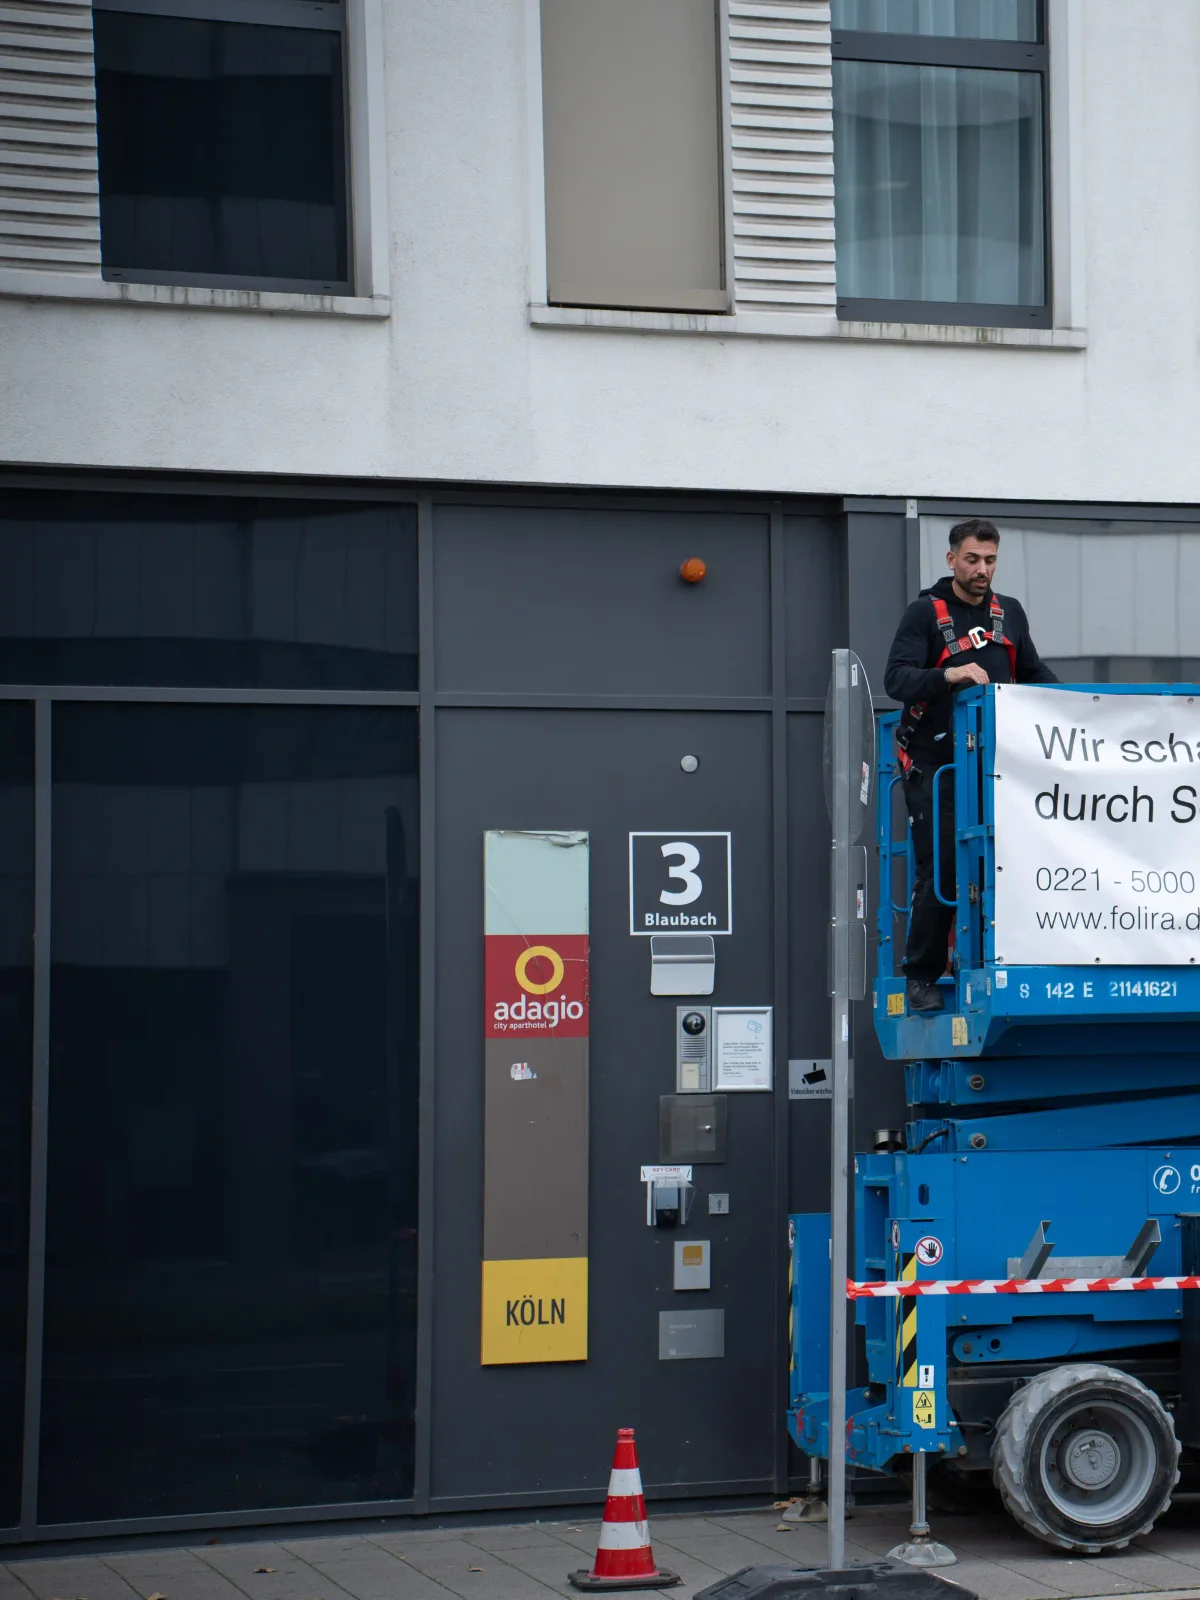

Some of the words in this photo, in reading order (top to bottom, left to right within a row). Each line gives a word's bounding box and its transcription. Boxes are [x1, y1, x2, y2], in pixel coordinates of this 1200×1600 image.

[1034, 723, 1105, 763] Wir
[1034, 783, 1154, 823] durch
[659, 841, 703, 906] 3
[1035, 867, 1101, 892] 0221
[1131, 870, 1196, 894] 5000
[644, 912, 717, 926] Blaubach
[1019, 983, 1030, 999] S
[1045, 982, 1075, 999] 142
[1083, 981, 1094, 998] E
[1109, 981, 1177, 997] 21141621
[494, 993, 584, 1028] adagio
[494, 1022, 508, 1030] city
[509, 1021, 547, 1030] aparthotel
[506, 1294, 566, 1327] KÖLN
